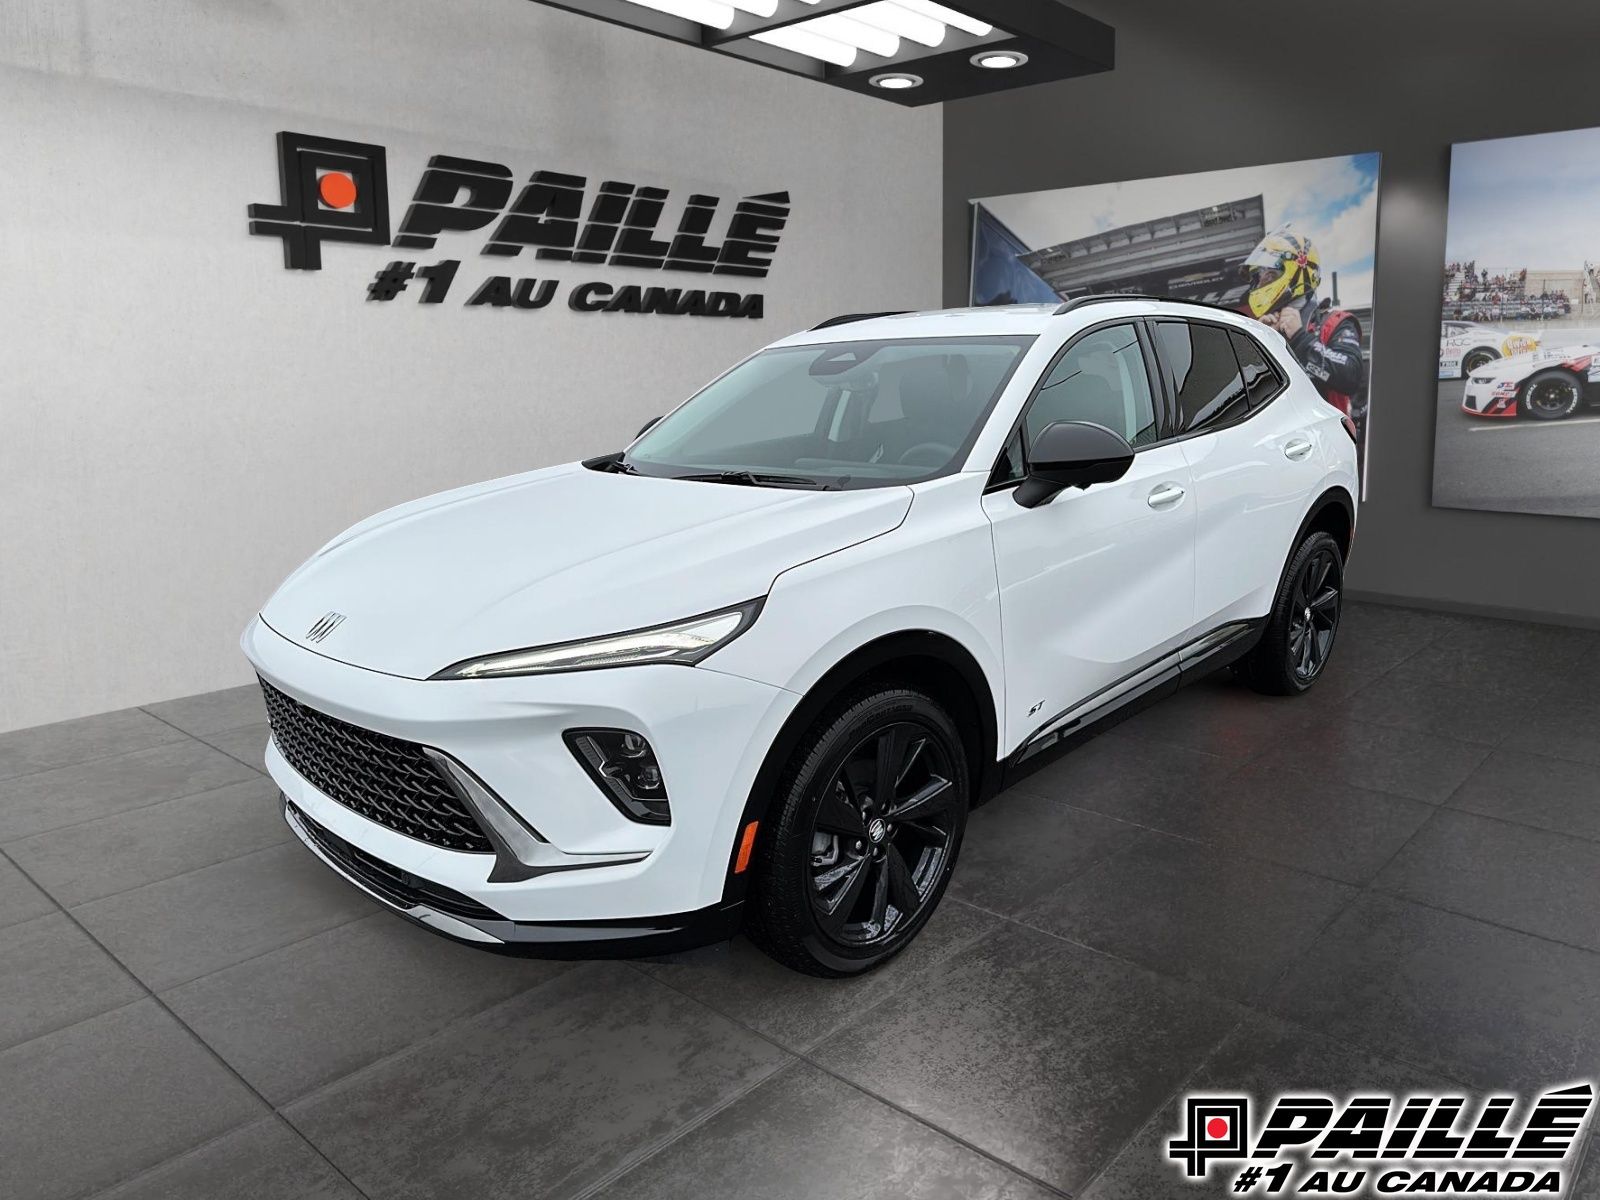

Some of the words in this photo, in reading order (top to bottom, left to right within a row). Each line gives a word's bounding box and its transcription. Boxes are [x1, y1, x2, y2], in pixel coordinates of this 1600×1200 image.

[391, 154, 790, 278] PAILLÉ
[365, 259, 462, 304] #1
[463, 275, 560, 310] AU
[568, 281, 764, 319] CANADA
